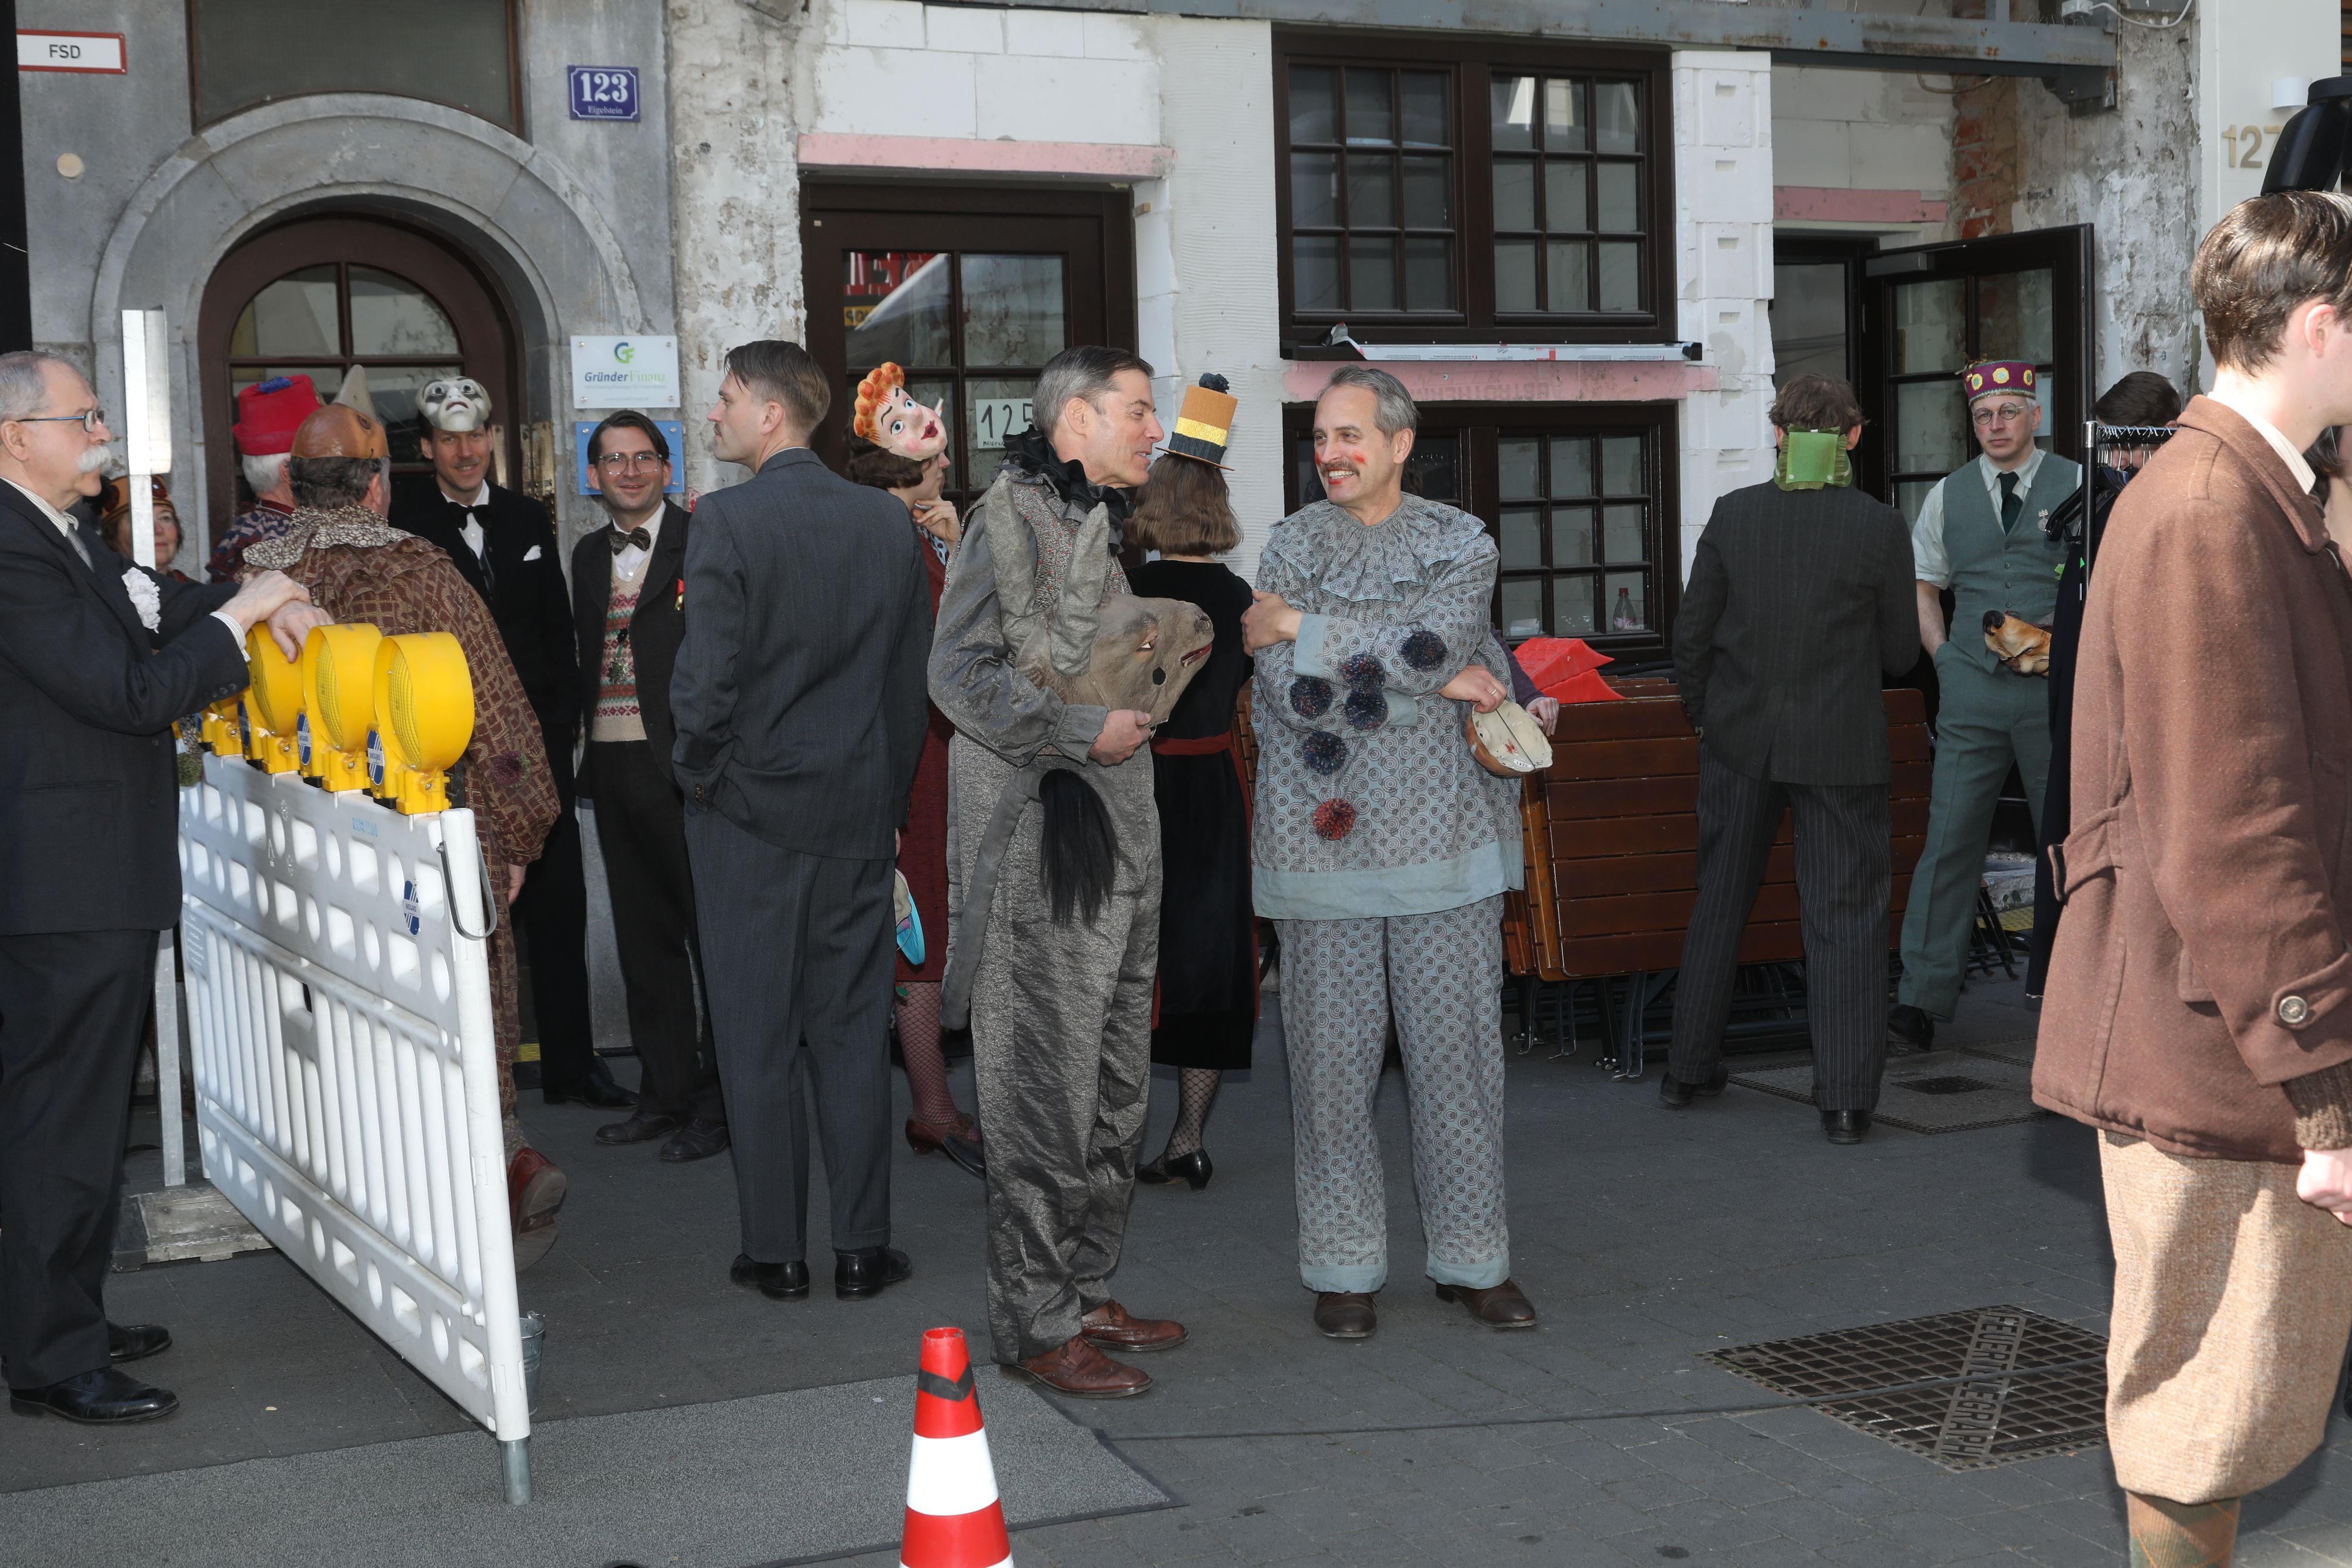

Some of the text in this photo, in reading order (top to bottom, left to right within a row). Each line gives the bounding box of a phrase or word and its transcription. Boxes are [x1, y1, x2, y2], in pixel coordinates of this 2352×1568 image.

[49, 44, 81, 59] FSD
[580, 72, 629, 103] 123
[587, 105, 623, 115] Eigelstein
[584, 372, 629, 382] Gründer
